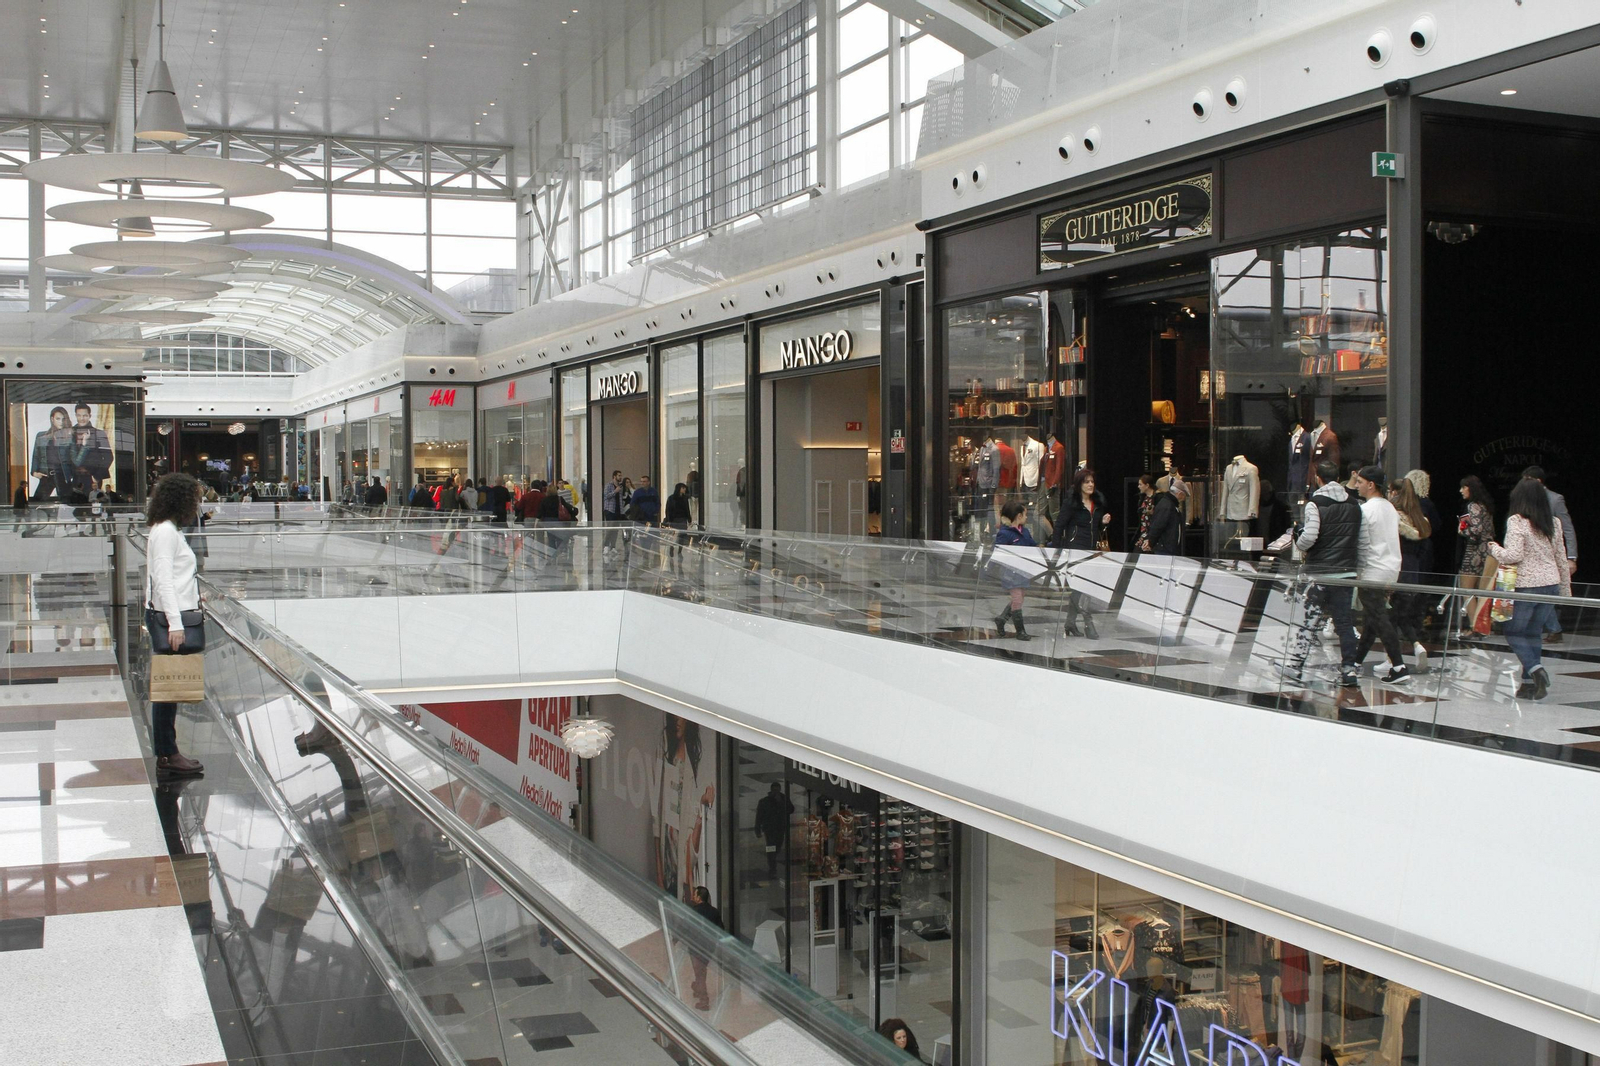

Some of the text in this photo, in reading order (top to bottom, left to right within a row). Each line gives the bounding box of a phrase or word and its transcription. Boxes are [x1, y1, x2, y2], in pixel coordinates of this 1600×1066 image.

[1065, 192, 1180, 242] GUTTERIDGE
[1100, 231, 1140, 249] DAL 1878
[780, 329, 852, 369] MANGO
[428, 388, 456, 407] H&M
[598, 370, 640, 399] MANGO
[1504, 454, 1542, 465] NAPOLI
[528, 696, 572, 738] GRAN
[528, 732, 571, 782] APERTURA
